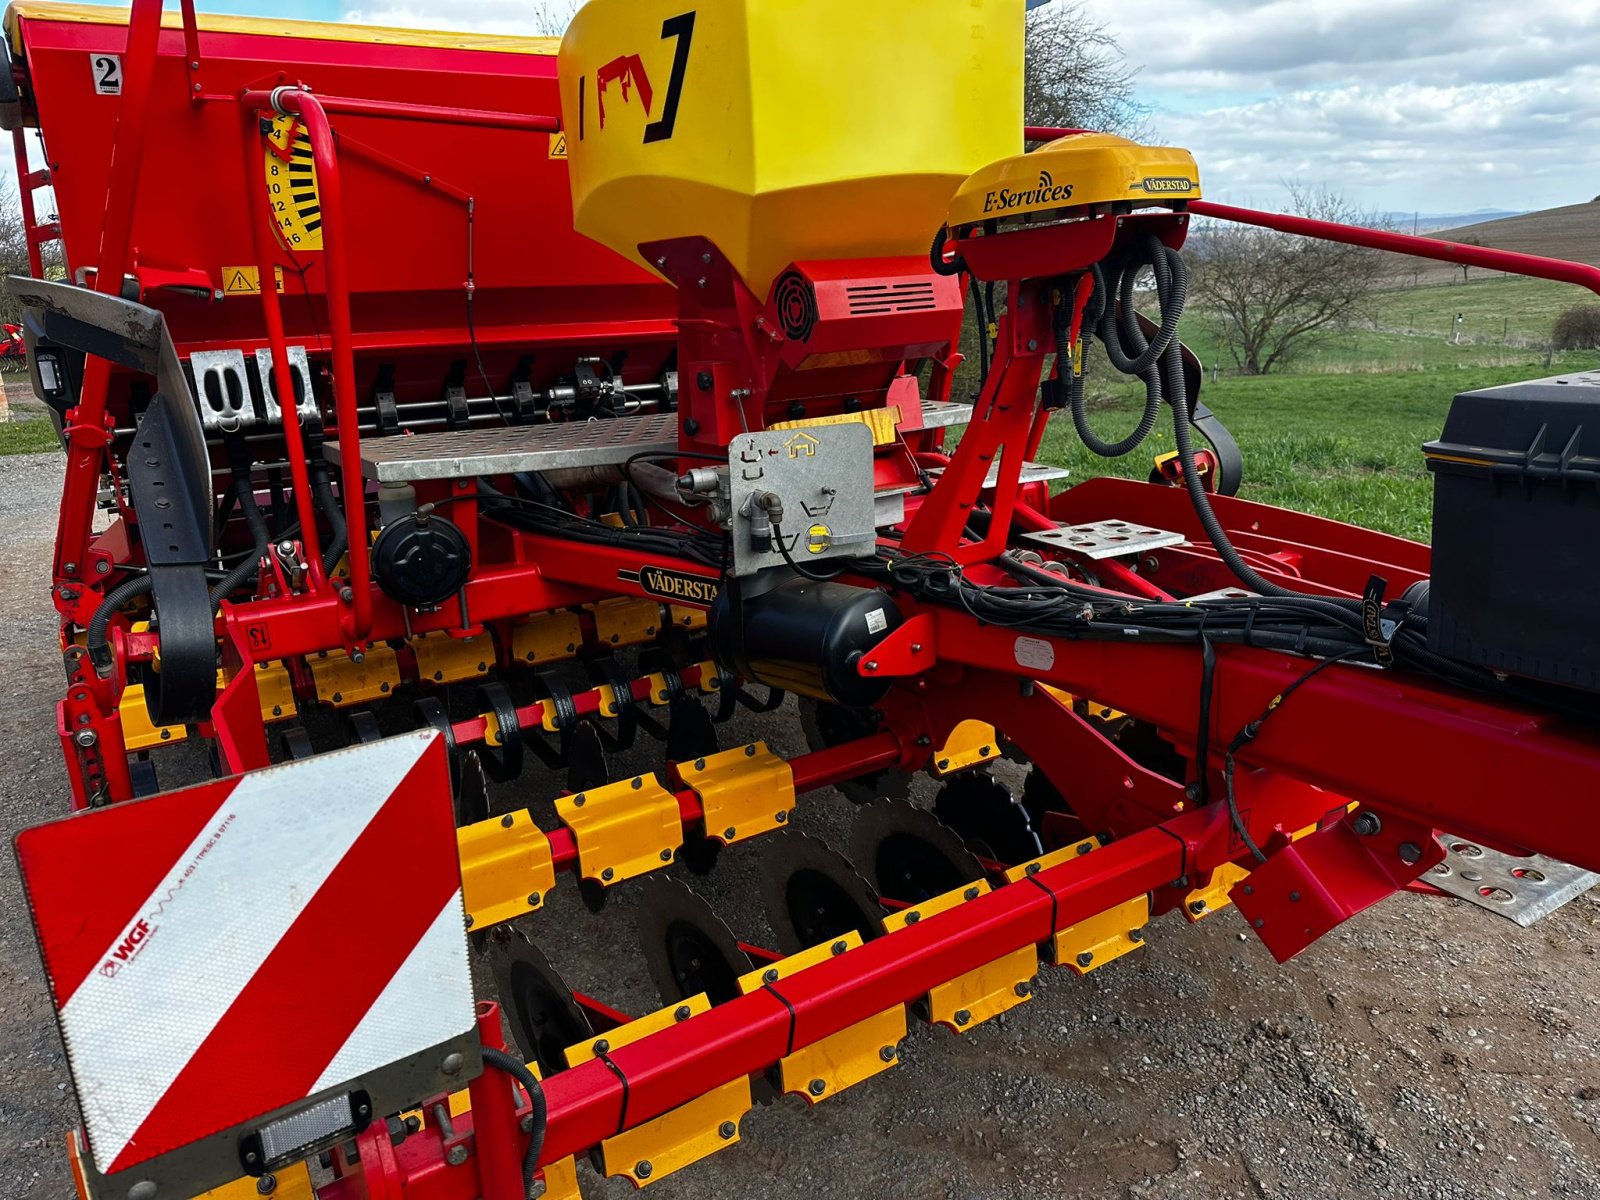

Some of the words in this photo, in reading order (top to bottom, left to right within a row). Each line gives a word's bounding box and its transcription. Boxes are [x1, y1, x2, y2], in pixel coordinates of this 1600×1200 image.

[96, 57, 119, 87] 2
[273, 129, 281, 140] 4
[271, 165, 279, 176] 8
[266, 183, 281, 194] 10
[1145, 178, 1190, 191] VÄDERSTAD
[983, 184, 1074, 213] E-Services
[270, 201, 286, 213] 12
[277, 217, 293, 230] 14
[286, 233, 301, 246] 16
[647, 570, 718, 602] VÄDERSTA
[113, 918, 150, 960] WGF
